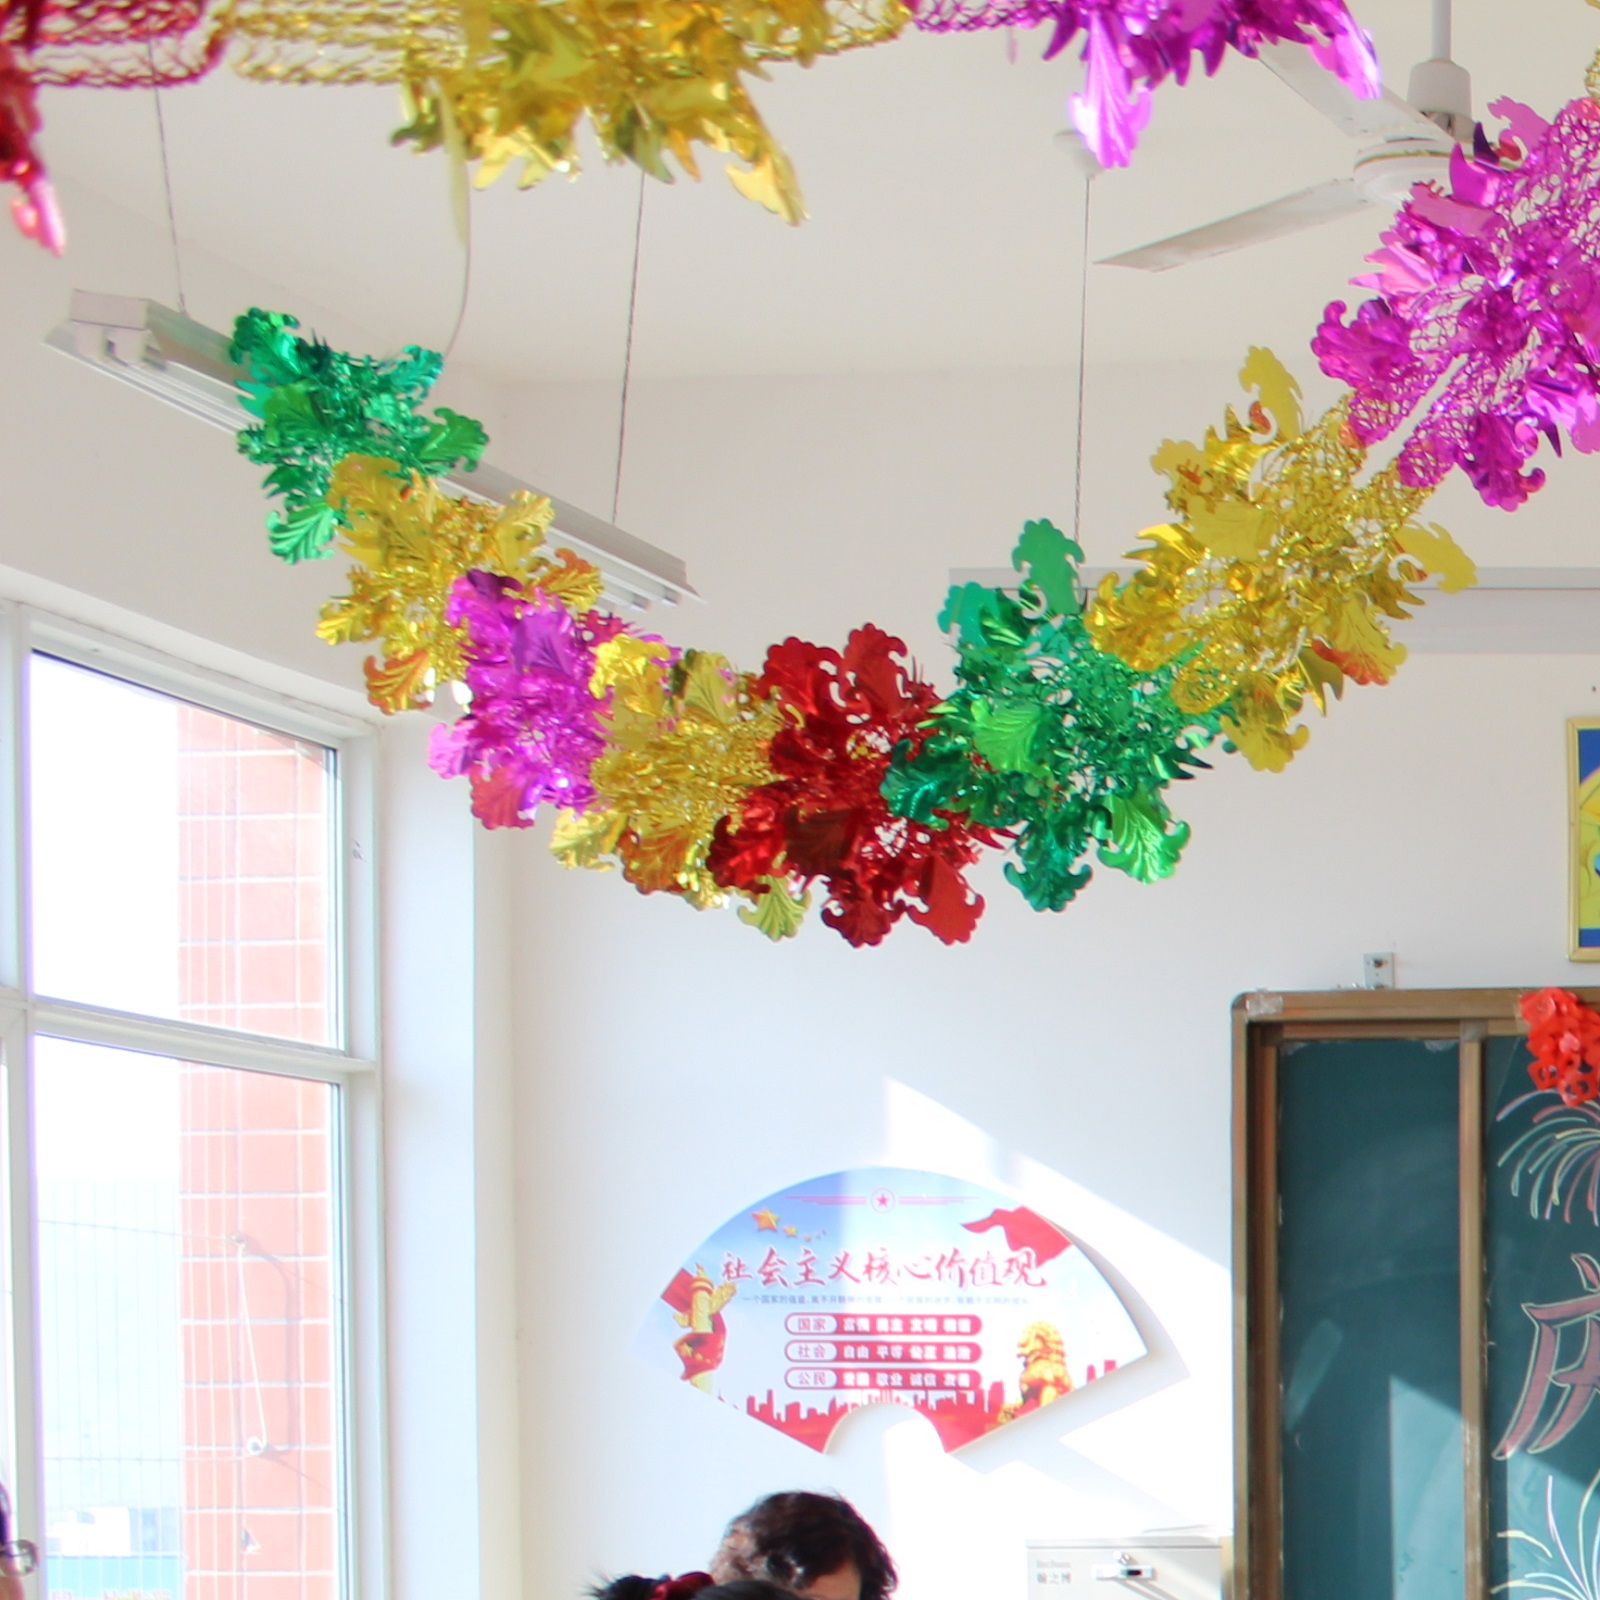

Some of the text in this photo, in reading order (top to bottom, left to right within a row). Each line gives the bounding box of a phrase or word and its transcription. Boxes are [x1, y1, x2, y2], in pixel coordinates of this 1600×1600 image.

[719, 1246, 1047, 1290] 社会主义核心价值观
[797, 1317, 827, 1332] 国家
[797, 1345, 827, 1360] 社会
[843, 1345, 870, 1360] 自由
[876, 1345, 903, 1360] 平等
[797, 1372, 827, 1387] 公民
